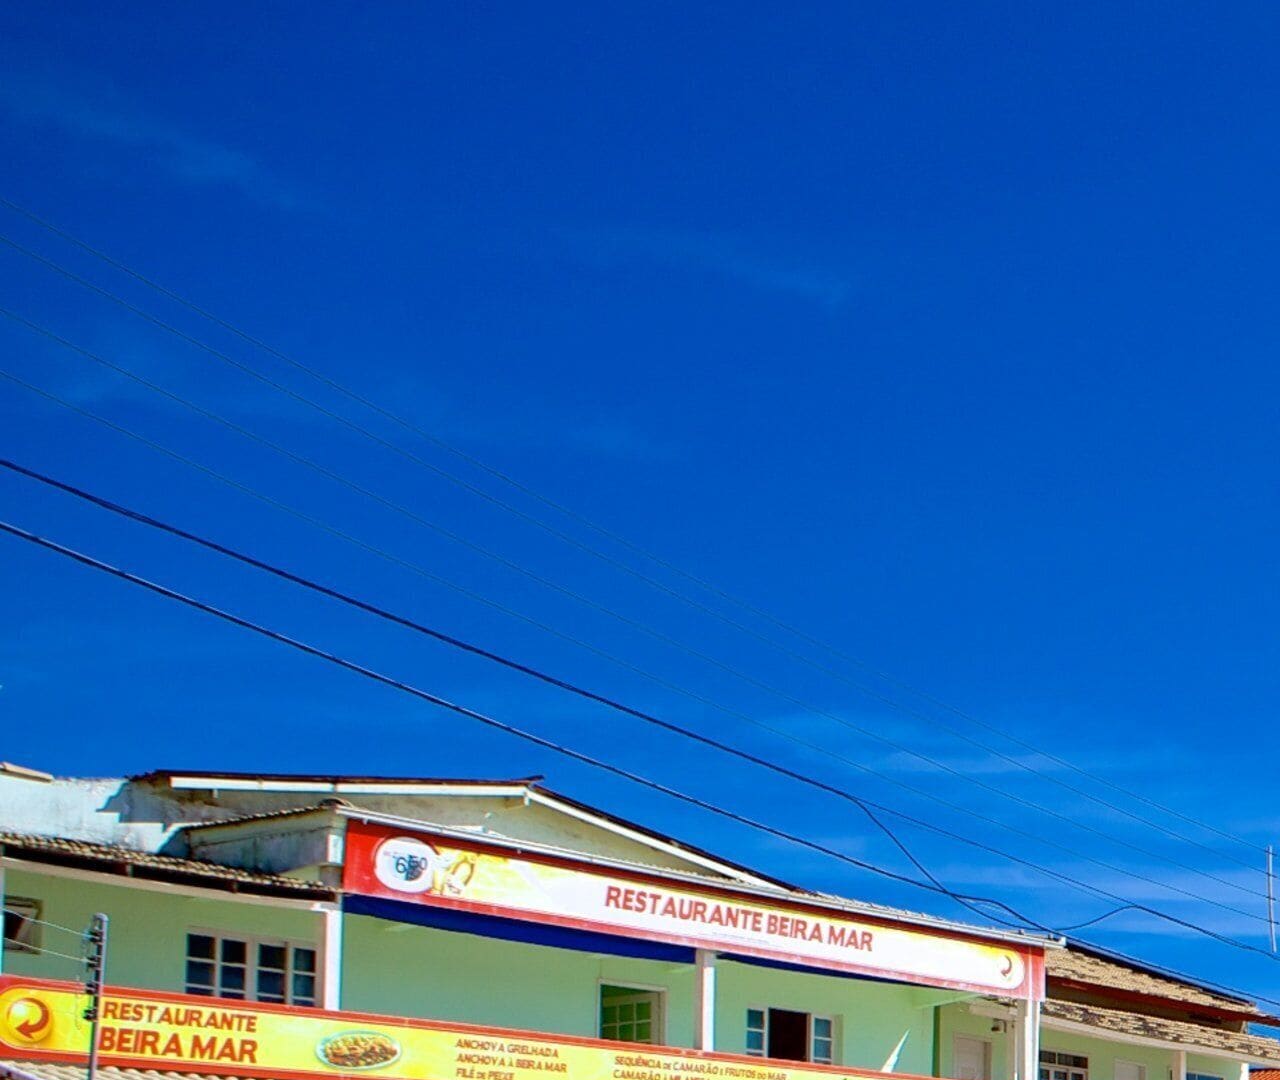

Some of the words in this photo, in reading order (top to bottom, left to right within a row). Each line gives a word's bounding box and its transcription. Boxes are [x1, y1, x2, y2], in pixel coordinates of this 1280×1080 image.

[604, 885, 762, 932] RESTAURANTE
[765, 913, 826, 944] BEIRA
[827, 925, 874, 951] MAR
[103, 1001, 258, 1033] RESTAURANTE
[100, 1026, 184, 1057] BEIRA
[189, 1035, 258, 1064] MAR
[456, 1038, 506, 1053] ANCHOVA
[506, 1043, 559, 1058] GRELHADA
[456, 1053, 506, 1067] ANCHOVA
[515, 1058, 542, 1071] BEIRA
[544, 1062, 568, 1073] MAR
[456, 1065, 475, 1079] FILÉ
[614, 1055, 661, 1069] SEQUÊNCIA
[663, 1062, 672, 1071] DE
[673, 1061, 718, 1076] CAMARÃO
[725, 1068, 756, 1079] FRUTOS
[757, 1072, 767, 1080] DO
